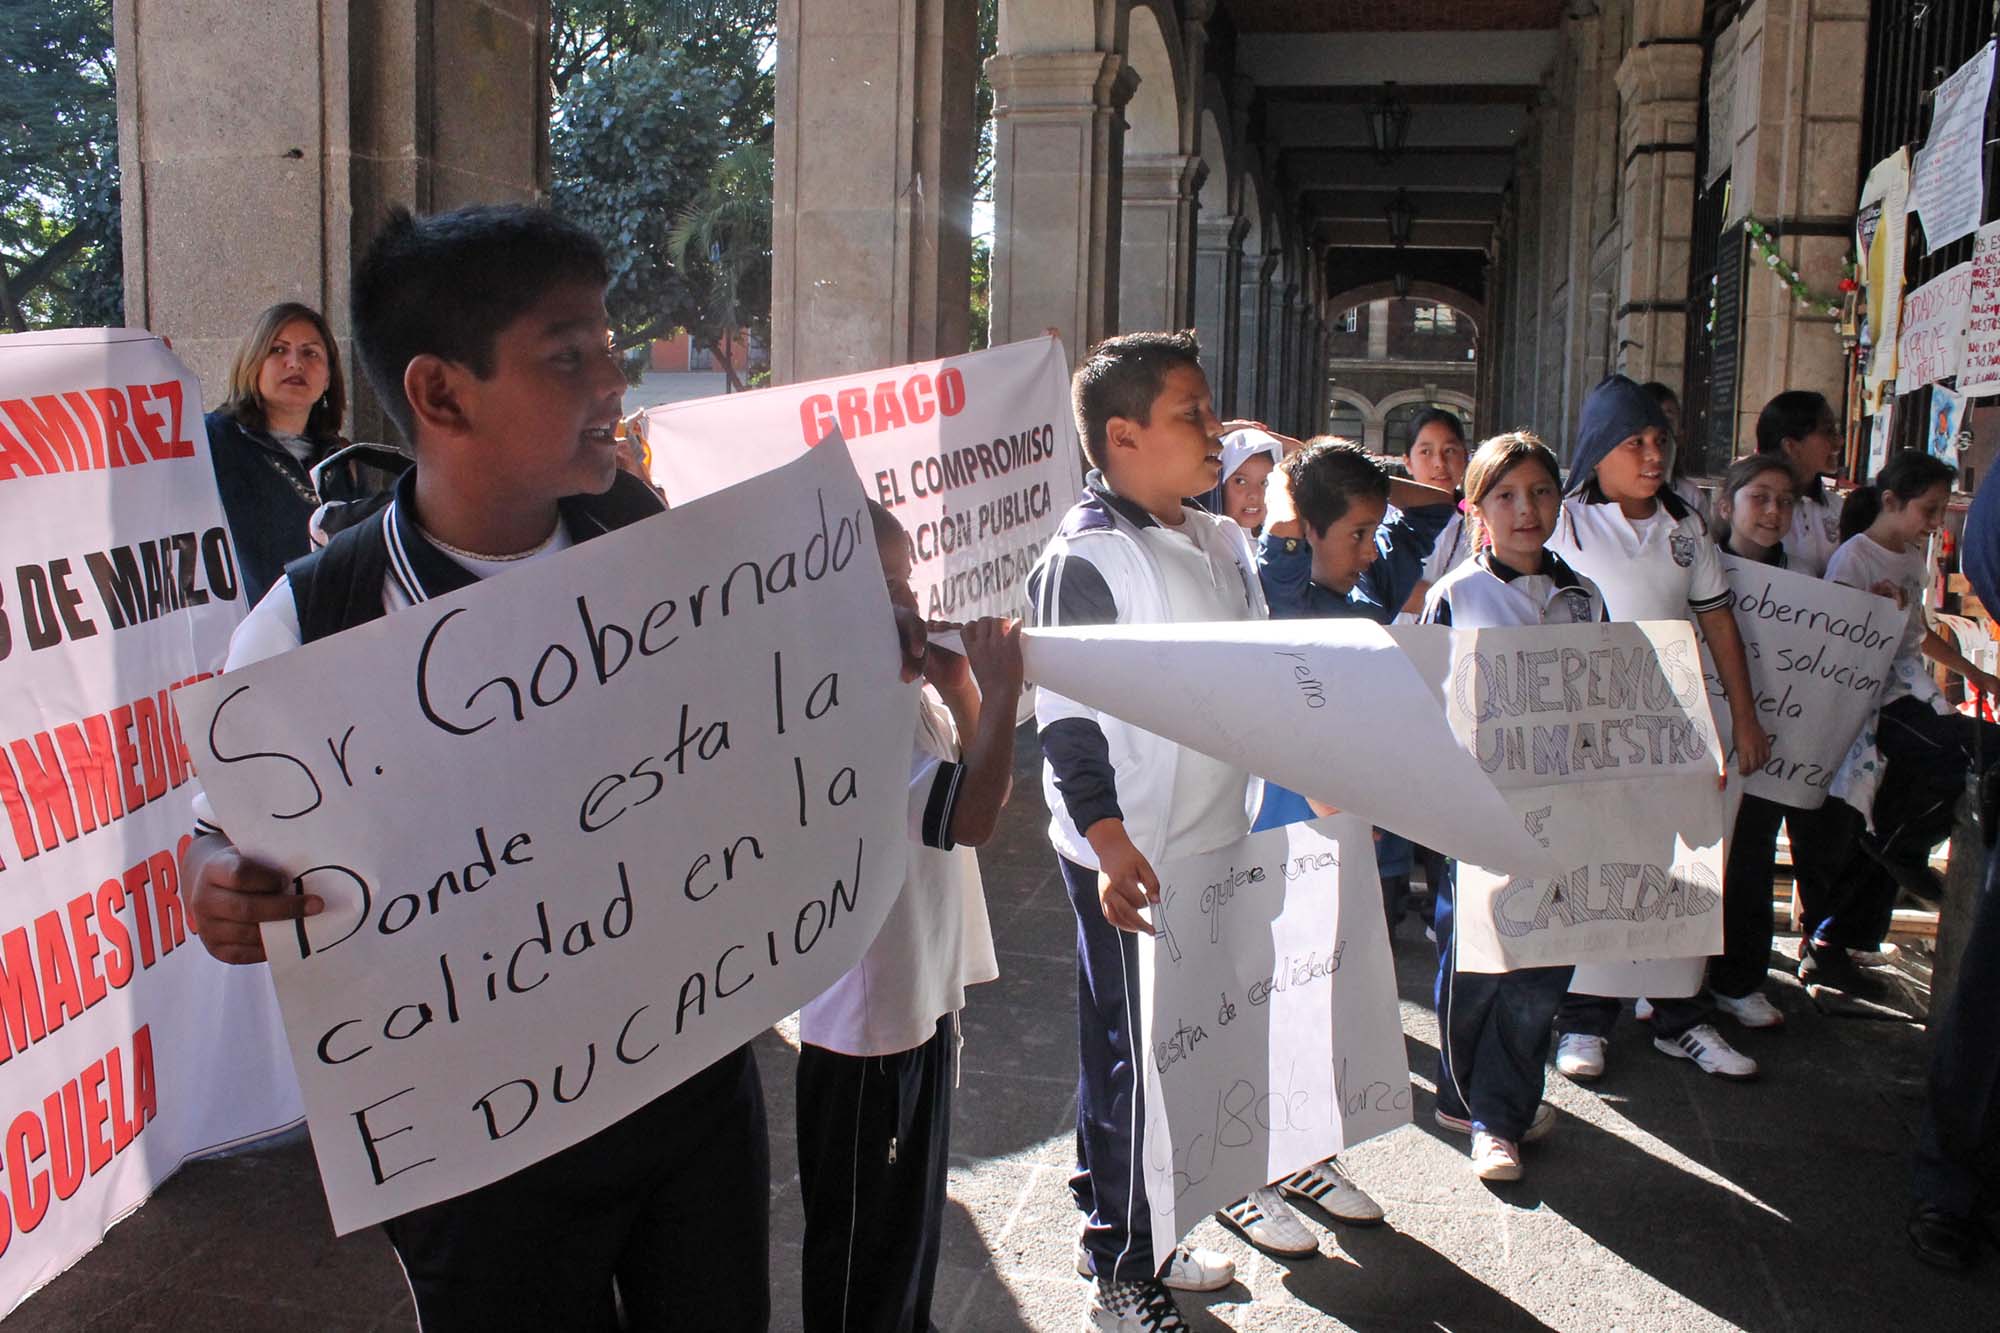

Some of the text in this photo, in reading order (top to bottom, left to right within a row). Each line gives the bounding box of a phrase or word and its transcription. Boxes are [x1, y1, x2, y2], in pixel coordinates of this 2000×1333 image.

[0, 380, 195, 480] AMIREZ
[800, 368, 965, 448] GRACO
[875, 424, 1054, 508] EL COMPROMISO
[979, 481, 1052, 540] PUBLICA
[16, 558, 98, 651] DE
[84, 527, 237, 630] MARZO
[928, 532, 1054, 620] AUTORIDAD
[1729, 583, 1894, 652] obernador
[208, 489, 866, 819] Sr. Gobernador
[1456, 640, 1700, 723] QUEREMOS
[0, 669, 224, 861] INMEDIA
[1472, 714, 1707, 775] UN MAESTRO
[293, 651, 839, 959] Donde esta la
[1280, 852, 1340, 881] una
[317, 756, 857, 1065] calidad en la
[1218, 992, 1237, 1026] de
[1248, 940, 1346, 1006] calidad
[0, 1023, 157, 1258] CUELA
